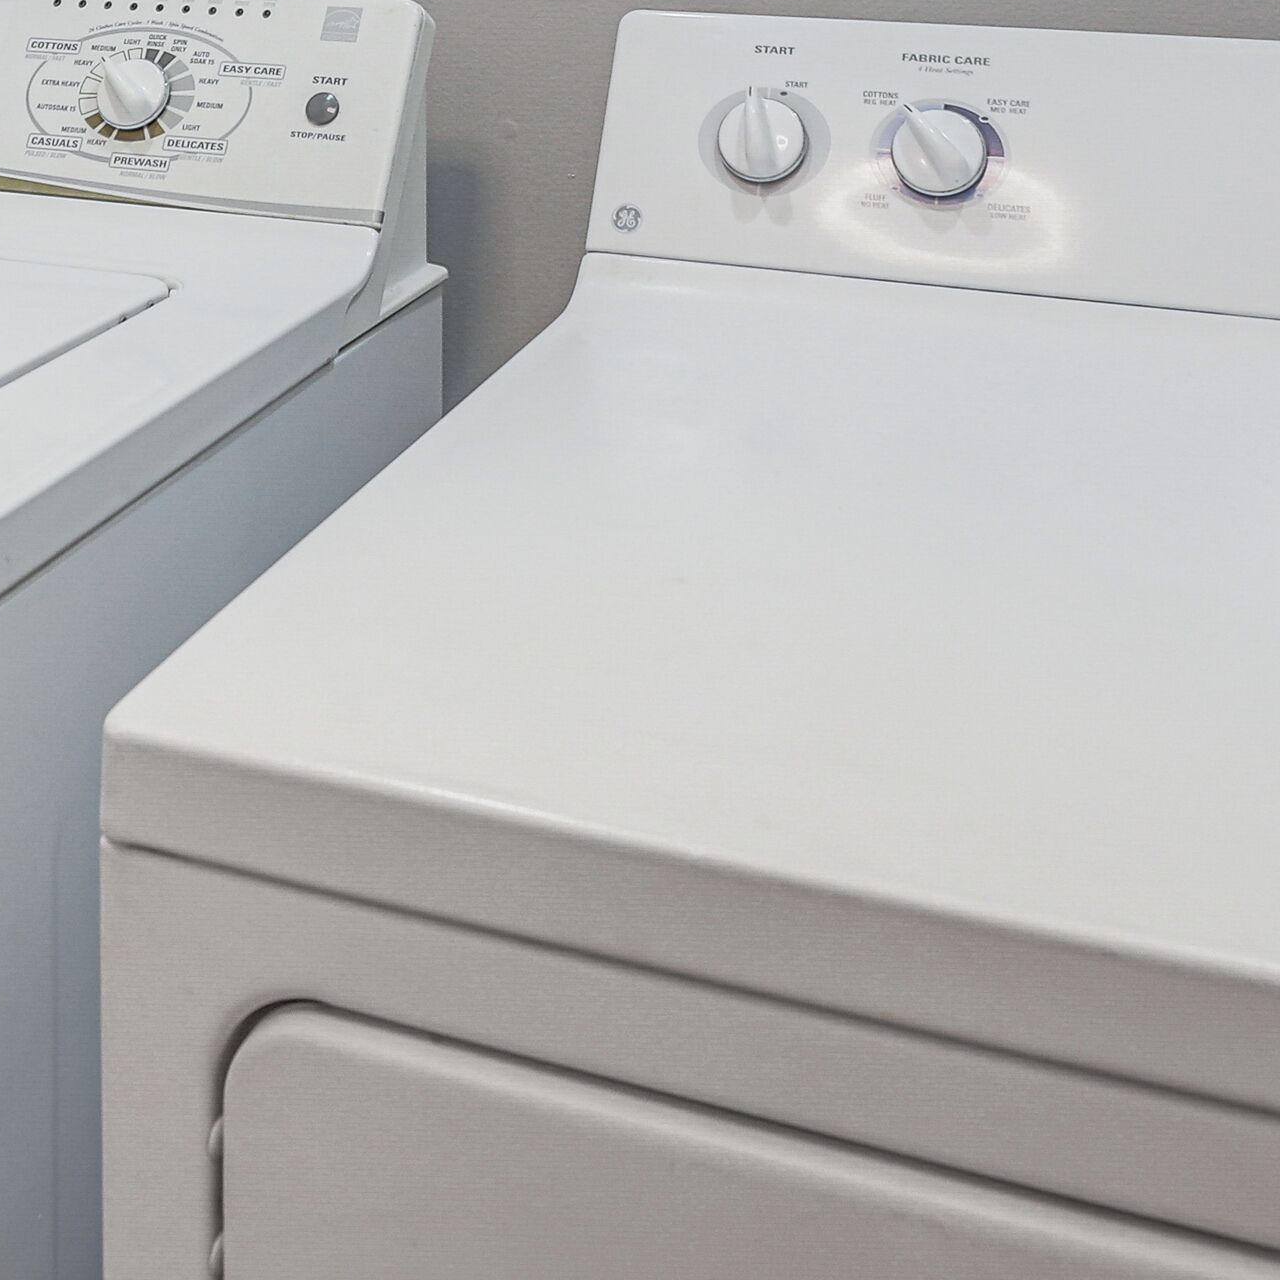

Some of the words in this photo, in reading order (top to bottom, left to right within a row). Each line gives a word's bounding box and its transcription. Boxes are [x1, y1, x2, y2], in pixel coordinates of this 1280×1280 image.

[30, 40, 79, 51] COTTONS
[91, 44, 117, 52] MEDIUM
[754, 44, 796, 56] START
[193, 50, 210, 58] AUTO
[901, 53, 951, 64] FABRIC
[954, 56, 991, 66] CARE
[222, 64, 252, 74] EASY
[253, 66, 283, 77] CARE
[312, 76, 349, 86] START
[785, 80, 808, 88] START
[862, 90, 899, 99] COTTONS
[36, 103, 68, 112] AUTOSOAK
[196, 101, 224, 110] MEDIUM
[987, 98, 1008, 106] EASY
[1009, 100, 1030, 108] CARE
[61, 126, 87, 134] MEDIUM
[181, 123, 200, 132] LIGHT
[290, 130, 346, 142] STOP/PAUSE
[31, 136, 79, 148] CASUALS
[86, 139, 107, 147] HEAVY
[166, 138, 224, 151] DELICATES
[113, 155, 168, 169] PREWASH
[987, 203, 1031, 213] DELICATES
